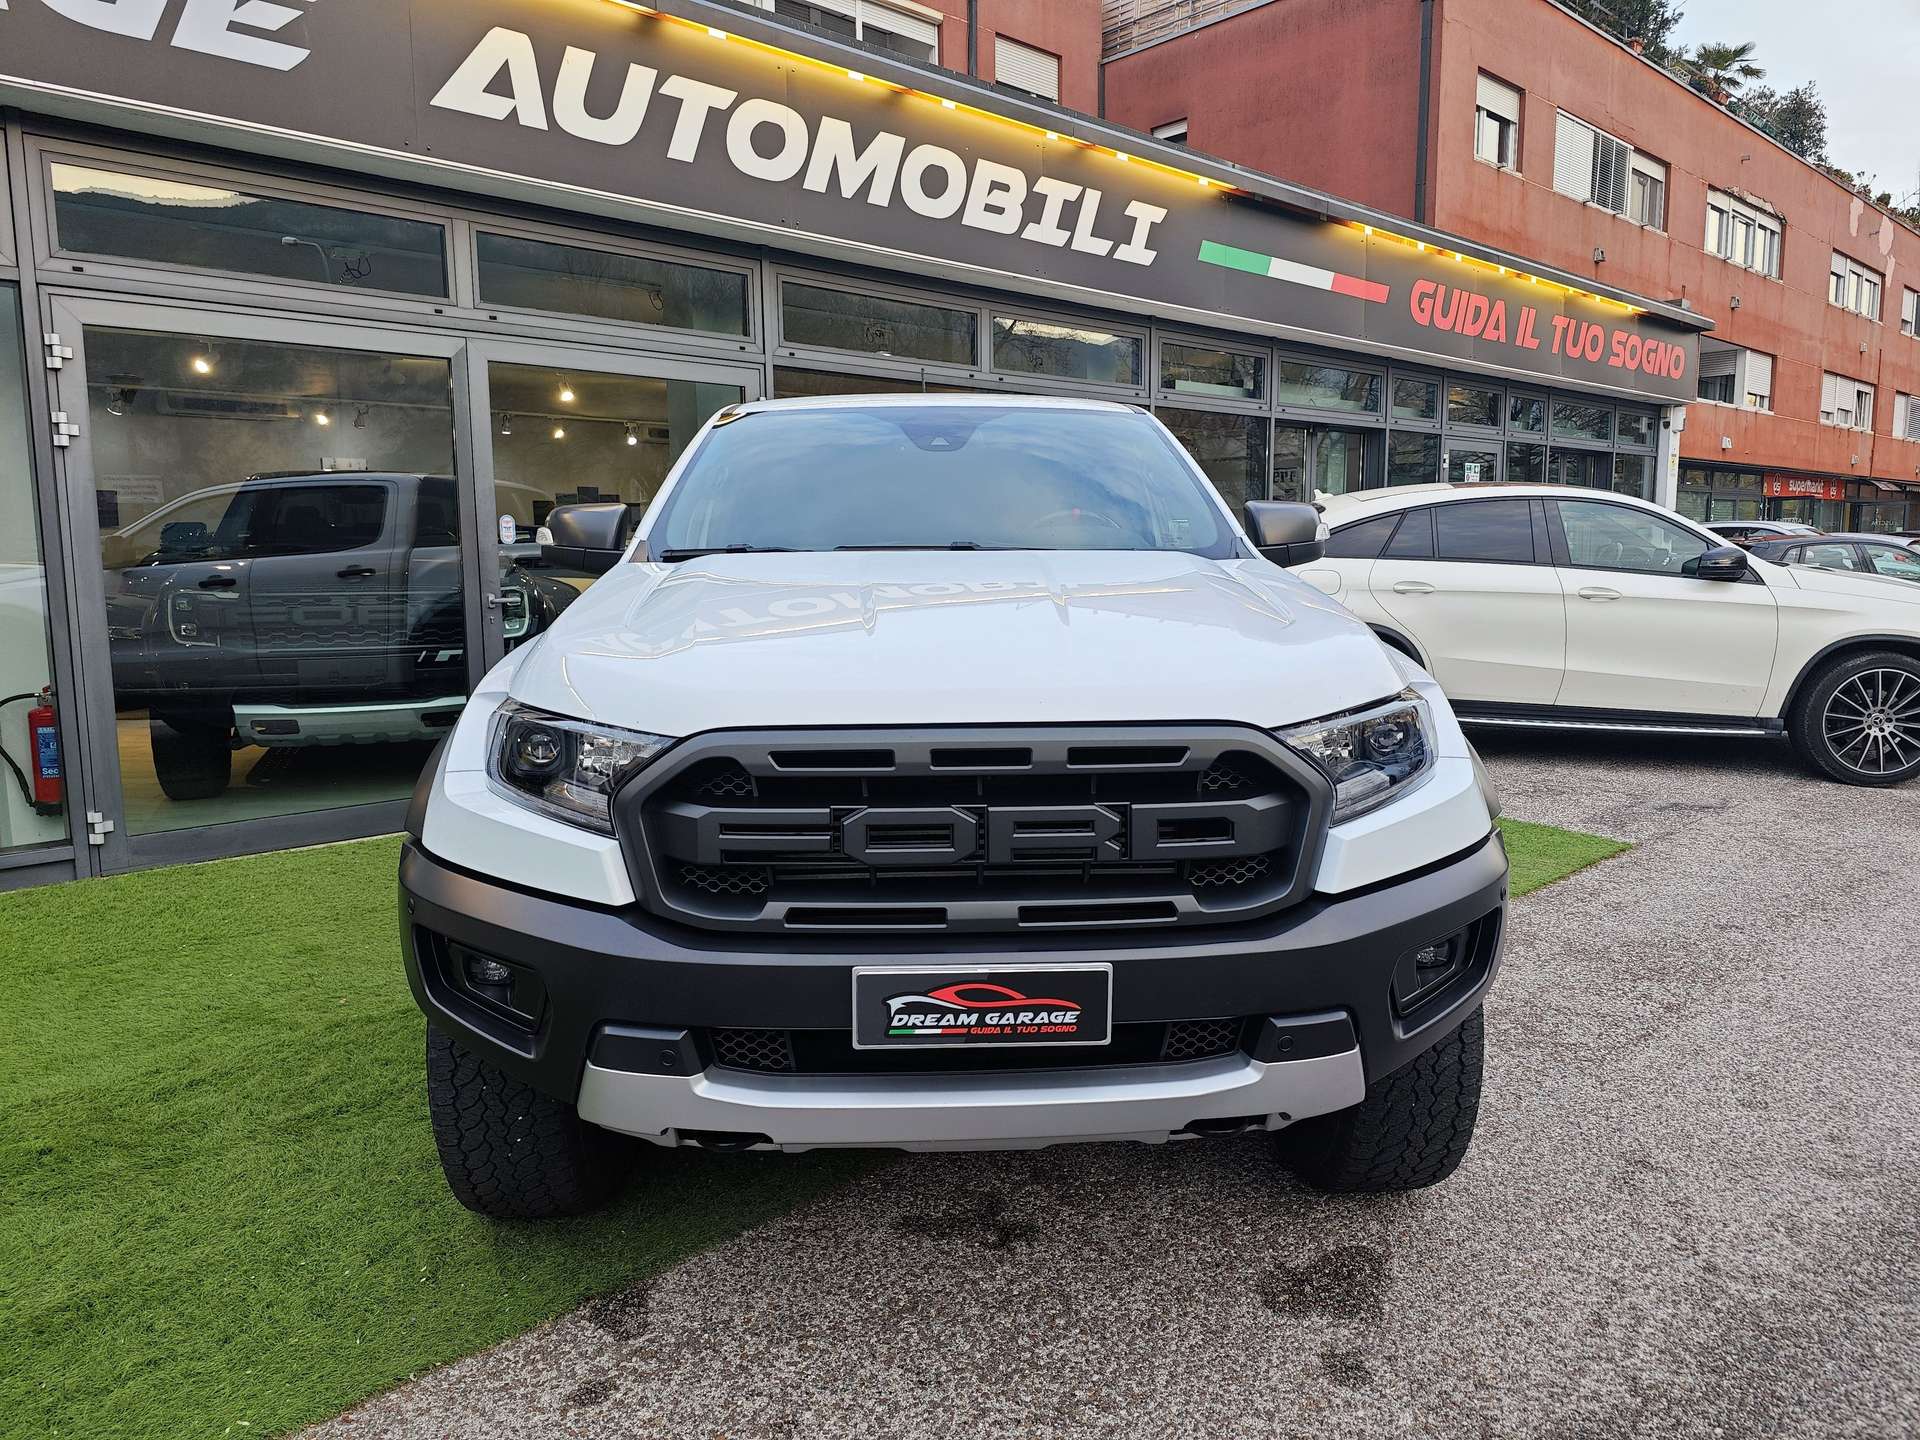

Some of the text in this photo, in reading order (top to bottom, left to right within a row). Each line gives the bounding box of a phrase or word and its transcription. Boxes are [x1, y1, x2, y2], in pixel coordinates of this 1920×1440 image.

[429, 26, 1168, 268] AUTOMOBILI
[1410, 278, 1686, 380] GUIDA IL TUO SOGNO
[1788, 479, 1825, 494] supermarkt
[685, 800, 1275, 866] FORD
[890, 1010, 1081, 1027] DREAM GARAGE
[970, 1026, 1001, 1034] GUIDA
[1017, 1025, 1038, 1033] TUO
[1040, 1025, 1077, 1033] SOGNO
